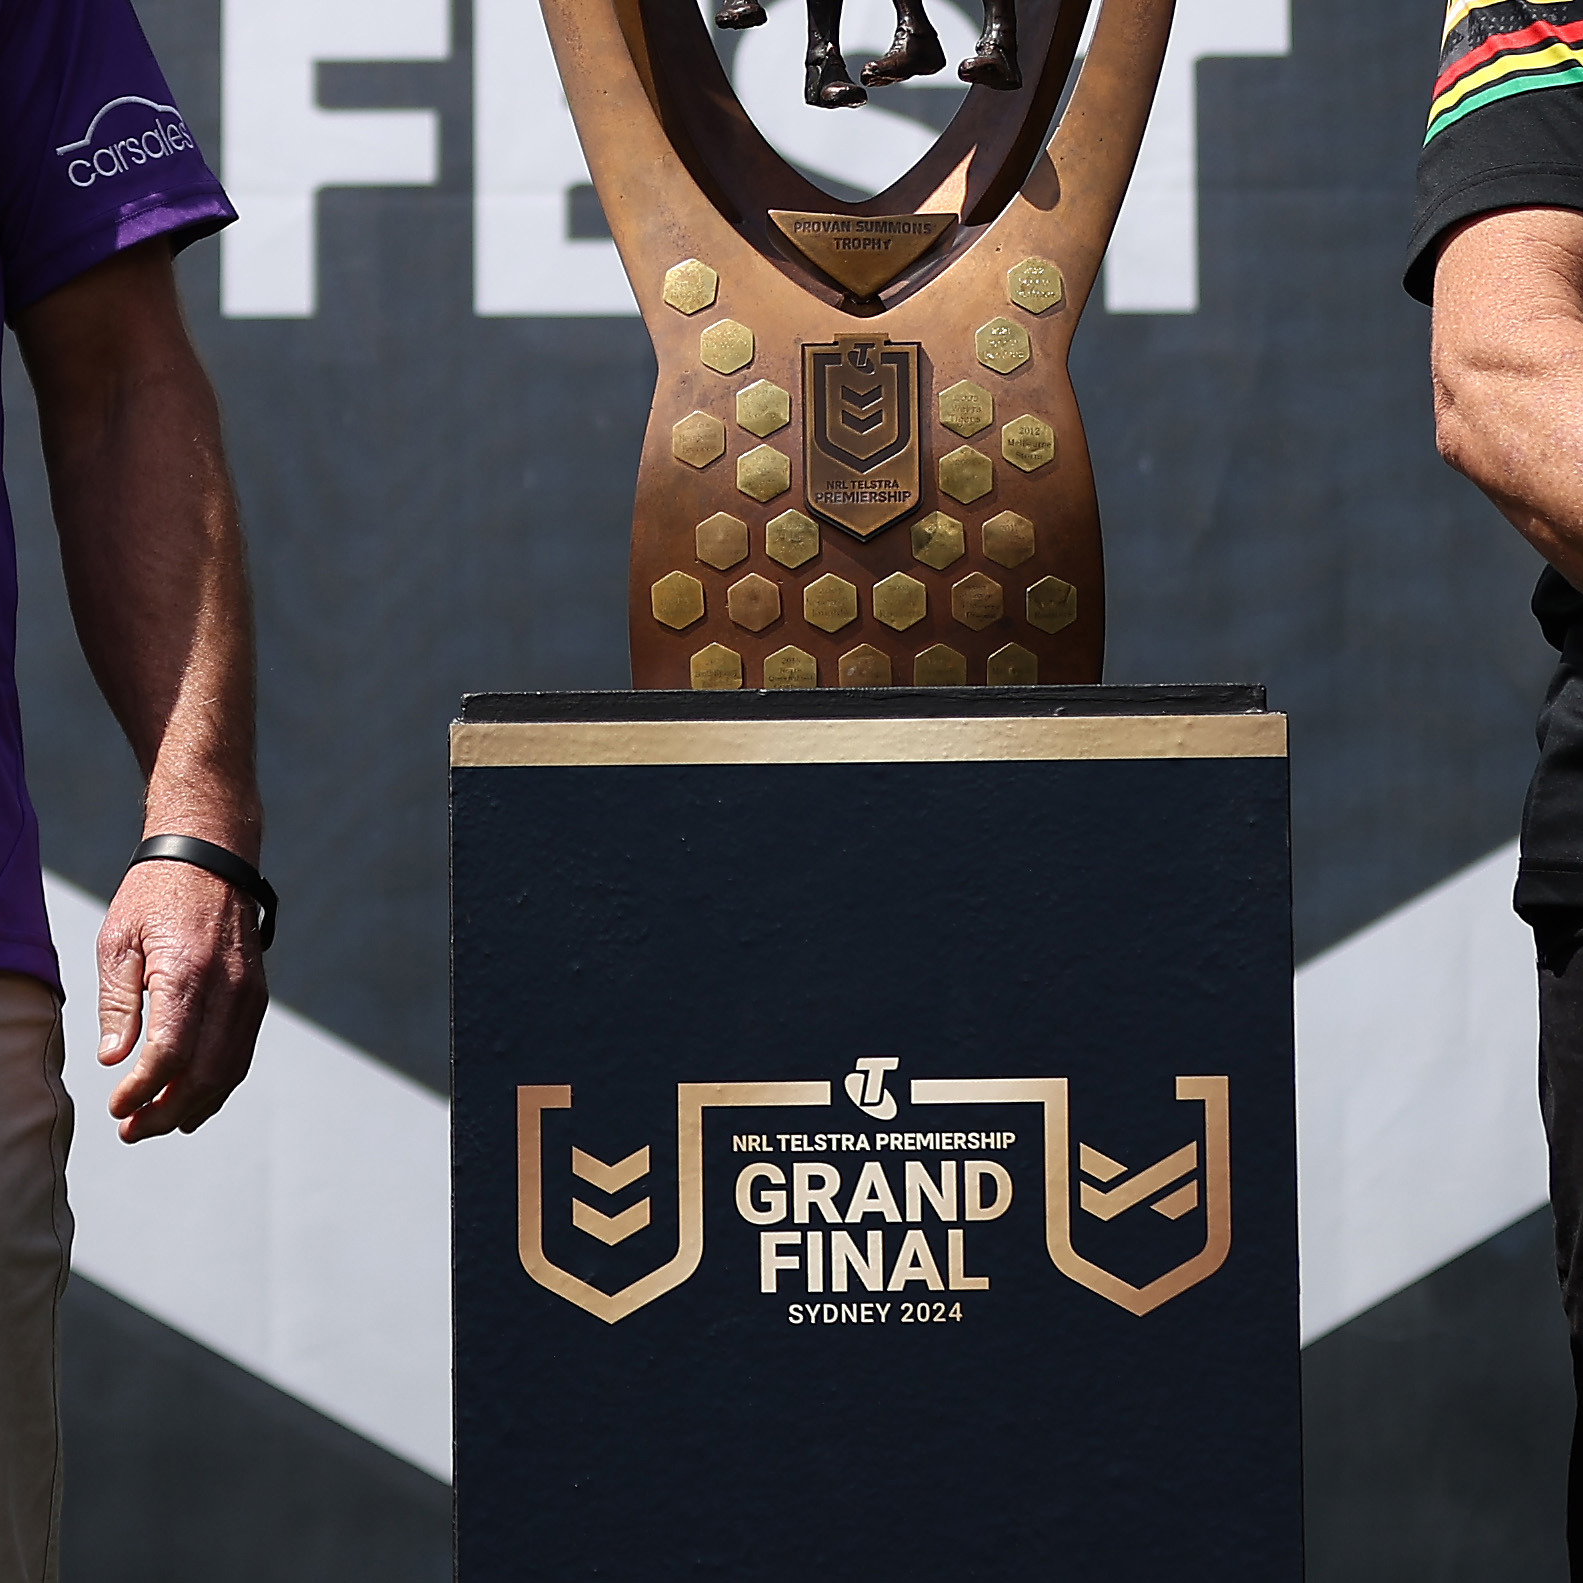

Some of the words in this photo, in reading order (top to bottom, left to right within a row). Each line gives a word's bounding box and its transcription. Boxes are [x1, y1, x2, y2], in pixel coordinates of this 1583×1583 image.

[793, 220, 852, 234] PROVAN
[855, 220, 933, 235] SUMMONS
[833, 237, 892, 251] TROPHY
[1019, 427, 1041, 436] 2012
[826, 480, 849, 490] NRL
[850, 479, 900, 490] TELSTRA
[816, 490, 912, 504] PREMIERSHIP
[731, 1134, 774, 1153] NRL
[776, 1133, 871, 1152] TELSTRA
[875, 1131, 1017, 1151] PREMIERSHIP
[734, 1159, 1014, 1226] GRAND
[759, 1228, 991, 1294] FINAL
[787, 1302, 892, 1324] SYDNEY
[900, 1301, 964, 1323] 2024
